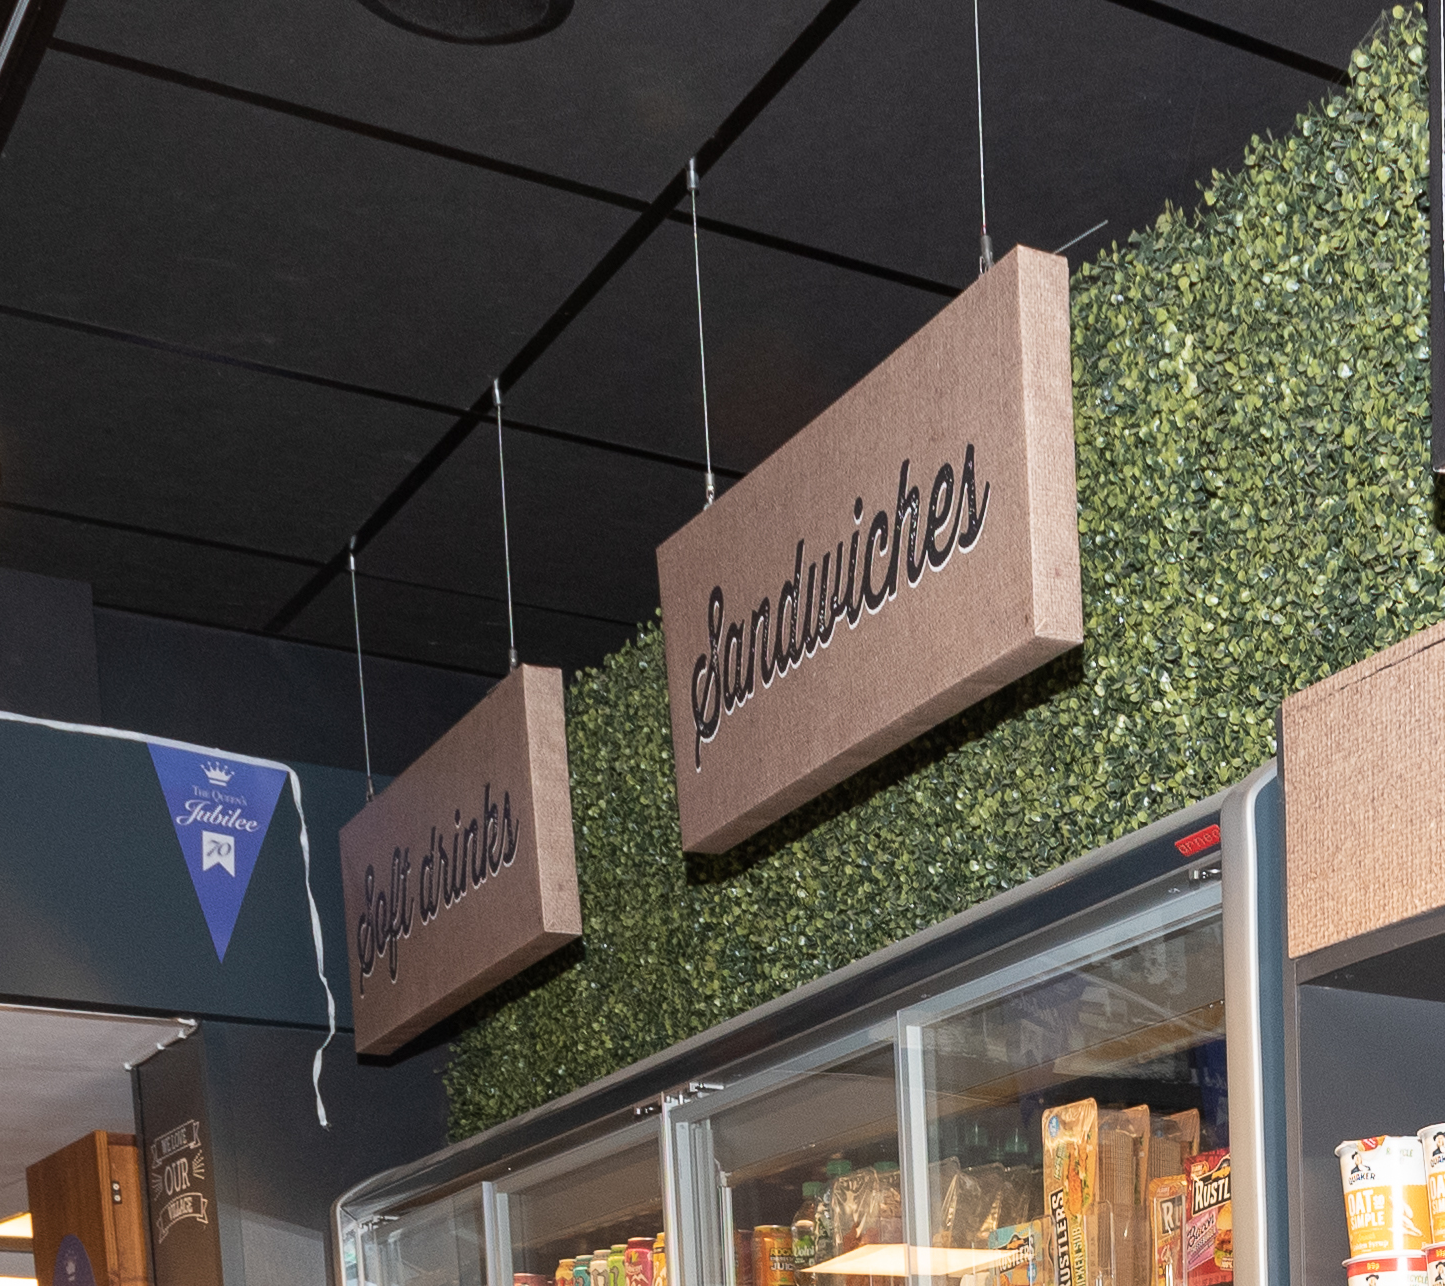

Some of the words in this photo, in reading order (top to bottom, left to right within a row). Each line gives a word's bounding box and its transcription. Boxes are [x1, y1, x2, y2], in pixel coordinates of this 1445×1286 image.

[692, 443, 990, 772] Sandwiches
[176, 799, 260, 833] Jubilee
[206, 839, 232, 857] 70
[358, 845, 416, 999] Soft
[419, 783, 519, 929] drinks
[164, 1157, 189, 1195] OUR
